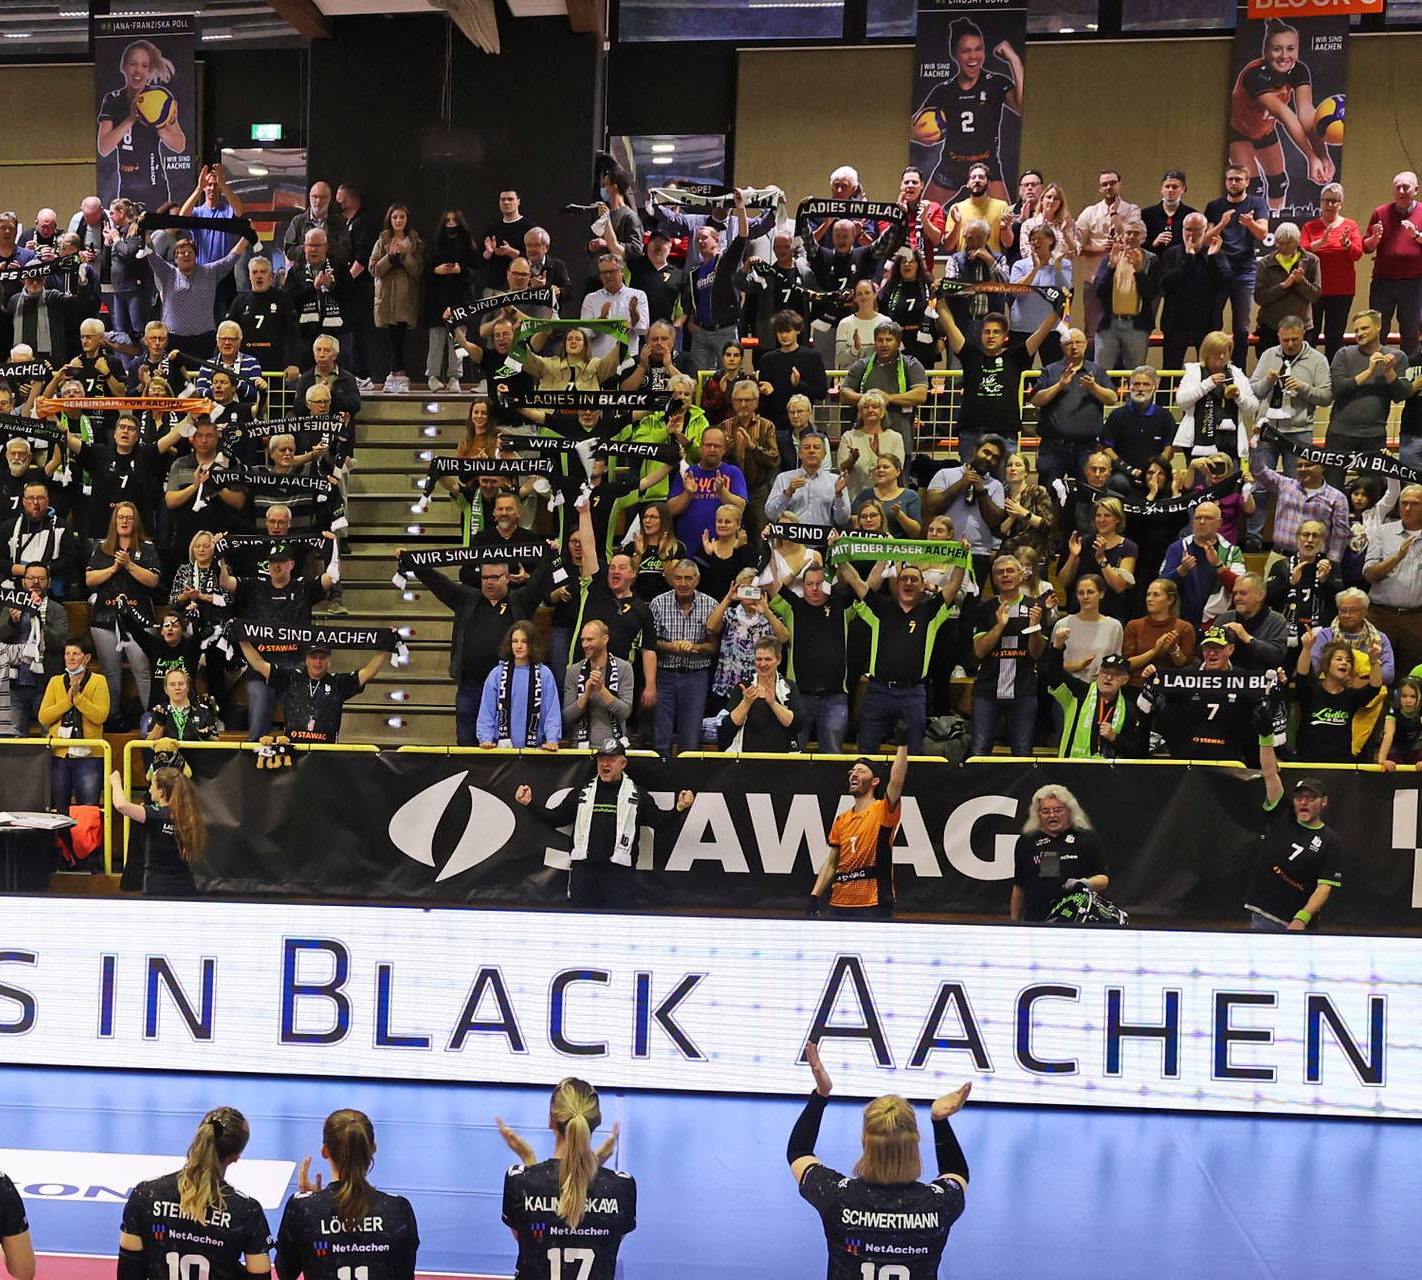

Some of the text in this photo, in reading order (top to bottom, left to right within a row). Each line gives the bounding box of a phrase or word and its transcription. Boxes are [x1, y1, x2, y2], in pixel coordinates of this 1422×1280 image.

[113, 20, 189, 32] JANA-FRANZISKA POLL
[1314, 42, 1342, 51] AACHEN
[923, 70, 950, 78] AACHEN
[961, 111, 974, 133] 2
[850, 203, 864, 214] IN
[21, 266, 51, 279] 2018
[469, 297, 498, 314] SIND
[905, 298, 916, 312] 7
[254, 314, 265, 329] 7
[525, 393, 648, 406] LADIES IN BLACK
[246, 421, 344, 439] LADIES IN BLACK
[529, 437, 658, 456] WIR AACHEN
[462, 459, 497, 473] SIND
[501, 458, 554, 474] AACHEN
[1292, 443, 1418, 481] LADIES BLACK
[244, 474, 276, 485] SIND
[282, 476, 332, 492] AACHEN
[1168, 494, 1216, 513] BLACK
[788, 526, 824, 540] SIND
[410, 544, 544, 567] WIR SIND AACHEN
[831, 543, 970, 559] MIT JEDER FASER AACHEN
[244, 623, 378, 645] WIR SIND AACHEN
[265, 644, 298, 652] STAWAG
[1164, 674, 1244, 689] LADIES IN
[1206, 704, 1220, 721] 7
[298, 730, 327, 740] STAWAG
[1287, 842, 1306, 861] 7
[97, 951, 218, 1042] IN
[277, 934, 709, 1063] BLACK
[795, 952, 1389, 1088] AACHEN
[842, 1207, 939, 1230] SCHWERTMANN
[168, 1228, 224, 1247] NetAachen
[549, 1224, 610, 1237] NetAachen
[332, 1242, 390, 1254] NetAachen
[864, 1242, 929, 1256] NetAachen
[546, 1246, 596, 1280] 17
